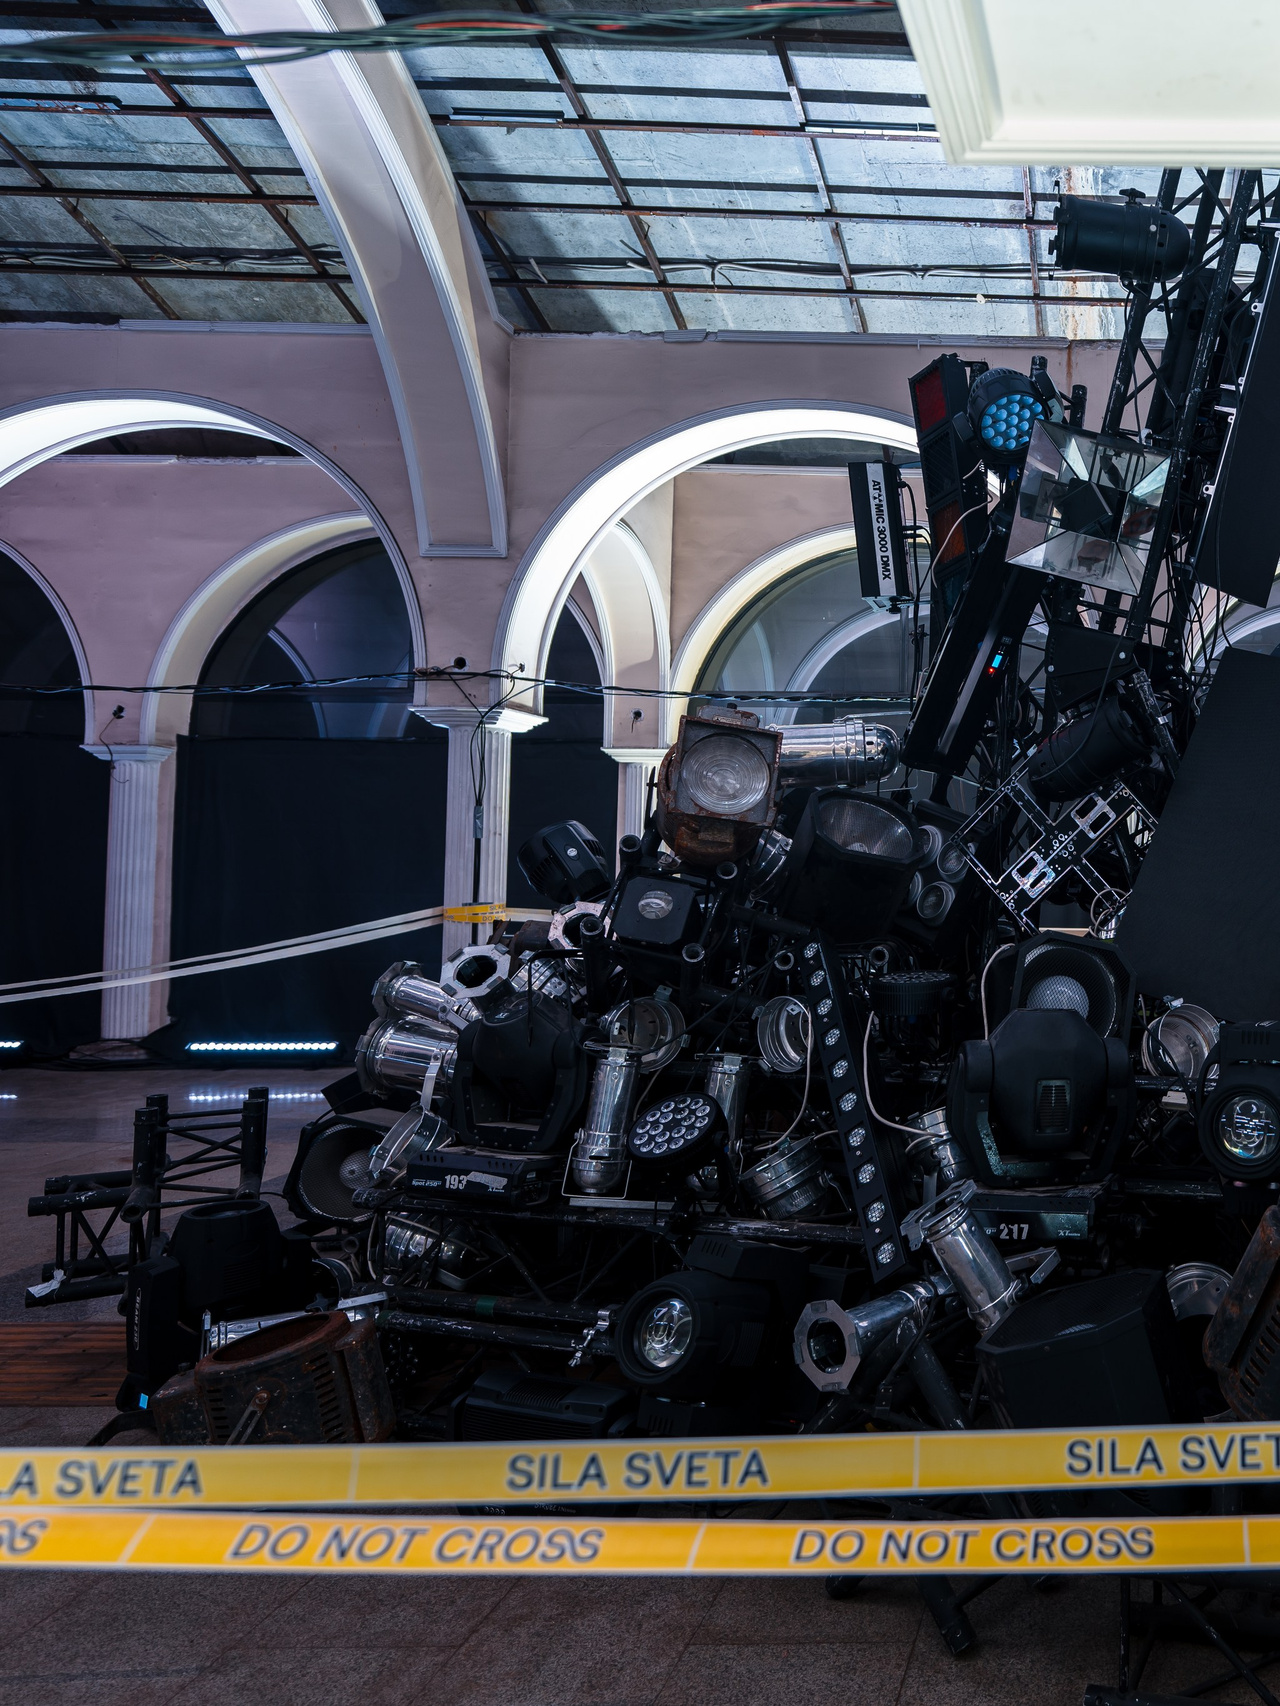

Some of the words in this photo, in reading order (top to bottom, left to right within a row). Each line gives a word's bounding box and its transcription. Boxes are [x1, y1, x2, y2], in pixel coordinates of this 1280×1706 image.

[876, 525, 889, 553] 3000
[880, 554, 892, 581] DMX
[444, 1174, 468, 1190] 193
[999, 1223, 1030, 1240] 217
[506, 1452, 608, 1491] SILA
[624, 1449, 770, 1489] SVETA
[1066, 1437, 1164, 1476] SILA
[56, 1459, 203, 1498] SVETA
[228, 1523, 311, 1560] DO
[317, 1525, 430, 1562] NOT
[434, 1527, 605, 1564] CROSS
[793, 1530, 866, 1563] DO
[879, 1529, 980, 1563] NOT
[992, 1526, 1155, 1562] CROSS
